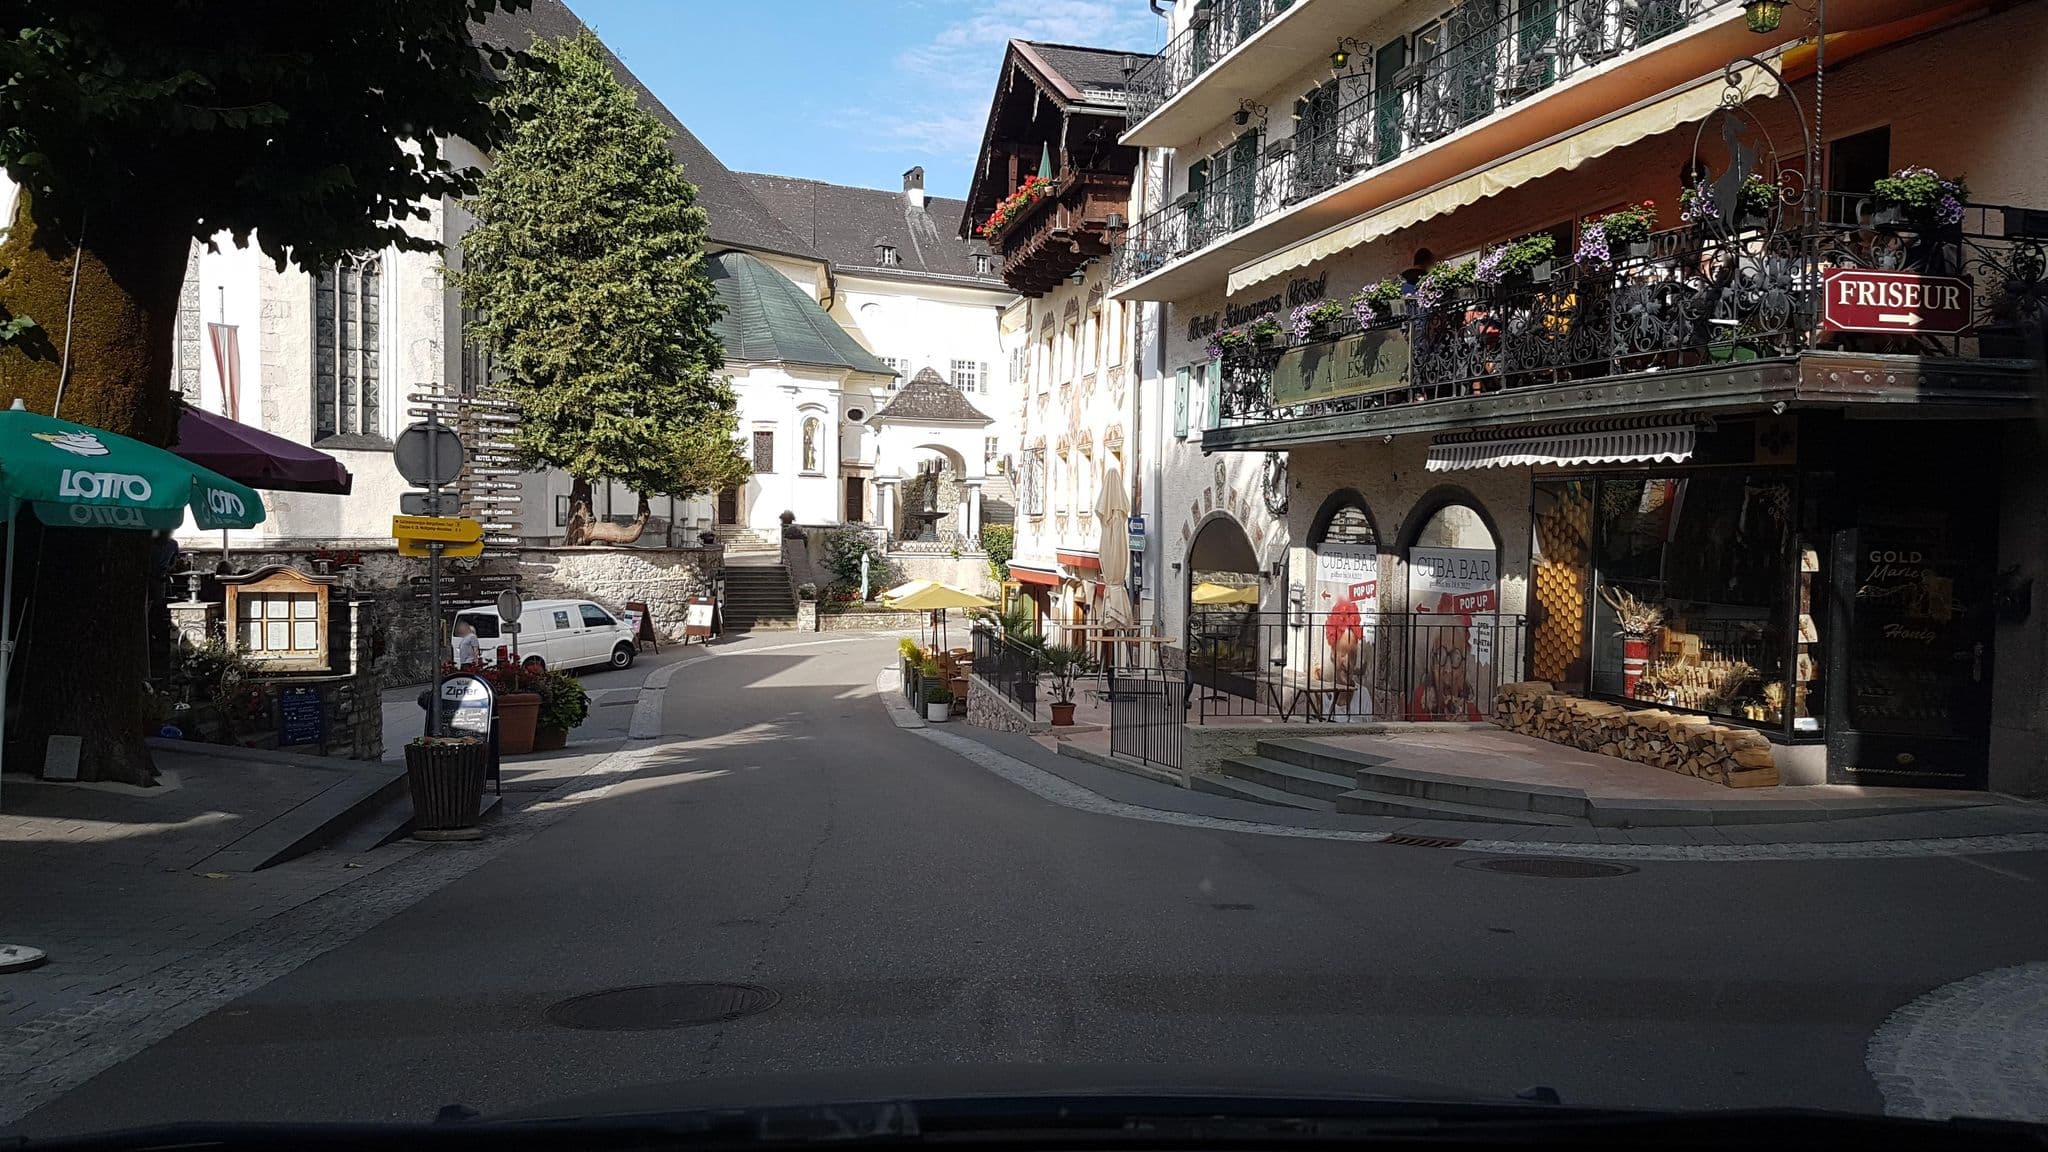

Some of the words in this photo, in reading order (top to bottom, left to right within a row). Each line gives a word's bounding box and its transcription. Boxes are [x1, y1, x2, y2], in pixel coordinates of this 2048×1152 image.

[1838, 280, 1960, 310] FRISEUR
[59, 469, 152, 501] LOTTO
[207, 487, 245, 518] LOTTO
[1322, 551, 1352, 571] CUBA
[1353, 553, 1377, 572] BAR
[1869, 550, 1922, 564] GOLD
[1416, 556, 1456, 579] CUBA
[1458, 559, 1491, 581] BAR
[1353, 585, 1366, 598] POP
[1365, 583, 1375, 596] UP
[1459, 596, 1476, 610] POP
[1476, 594, 1488, 608] UP
[446, 686, 479, 698] Zipfer
